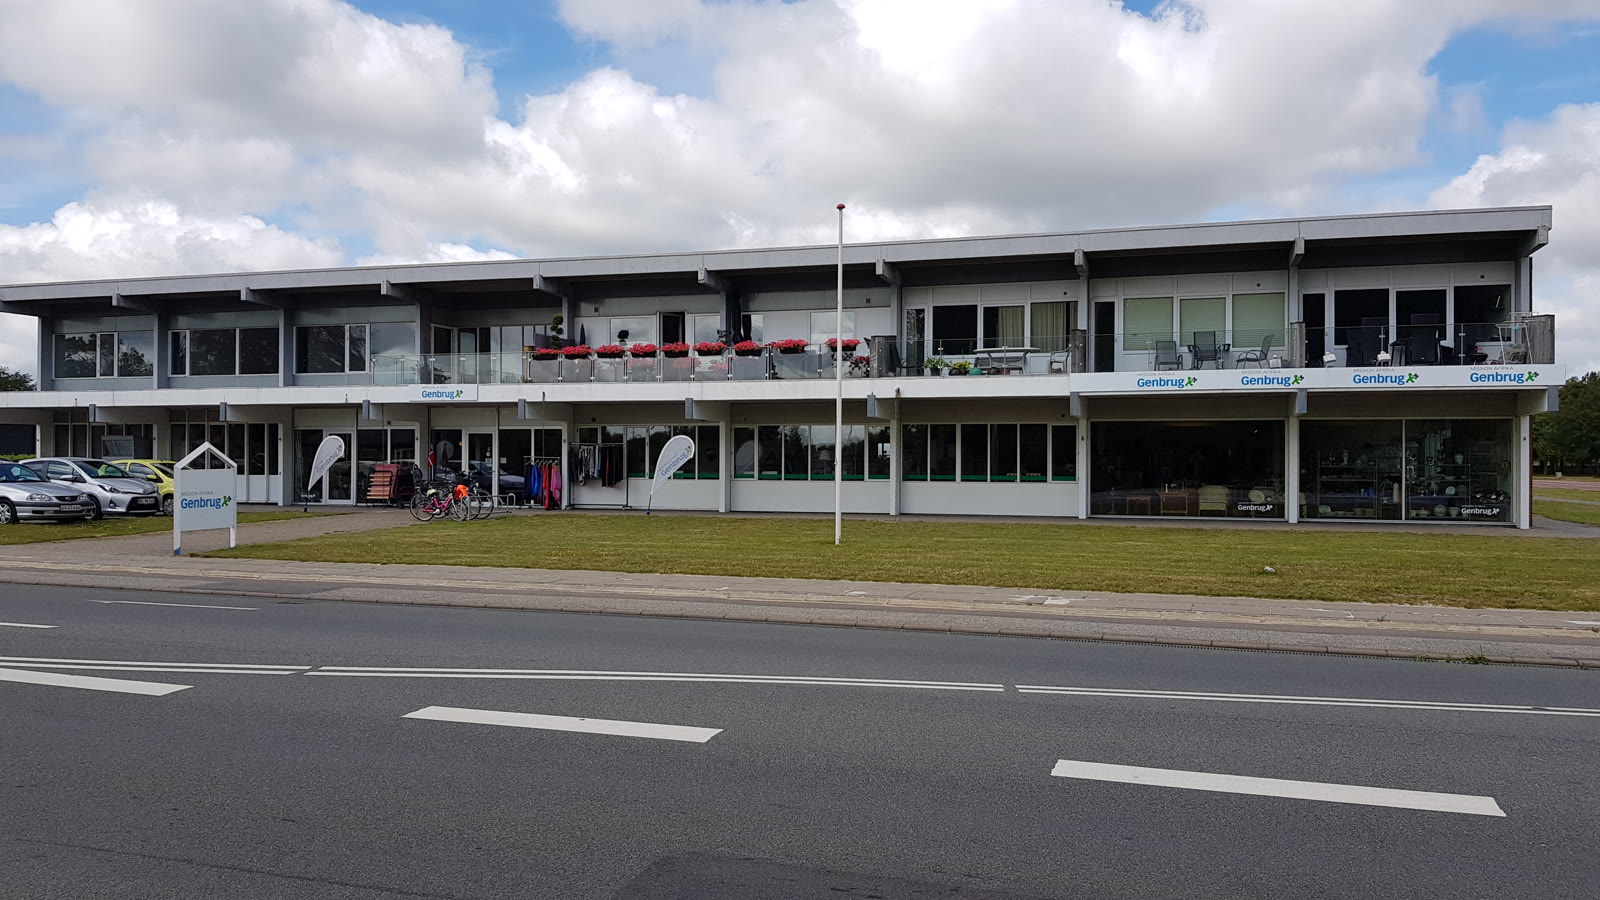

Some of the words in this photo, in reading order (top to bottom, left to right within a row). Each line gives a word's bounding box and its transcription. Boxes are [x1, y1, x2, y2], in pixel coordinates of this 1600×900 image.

[1137, 377, 1185, 388] Genbrug
[1241, 375, 1291, 387] Genbrug
[1353, 374, 1405, 386] Genbrug
[1470, 372, 1524, 384] Genbrug
[422, 390, 455, 399] Genbrug
[316, 450, 340, 474] Genbrug
[660, 451, 689, 476] Genbrug
[181, 497, 221, 509] Genbrug
[1237, 504, 1266, 512] Genbrug
[1461, 508, 1492, 516] Genbrug
